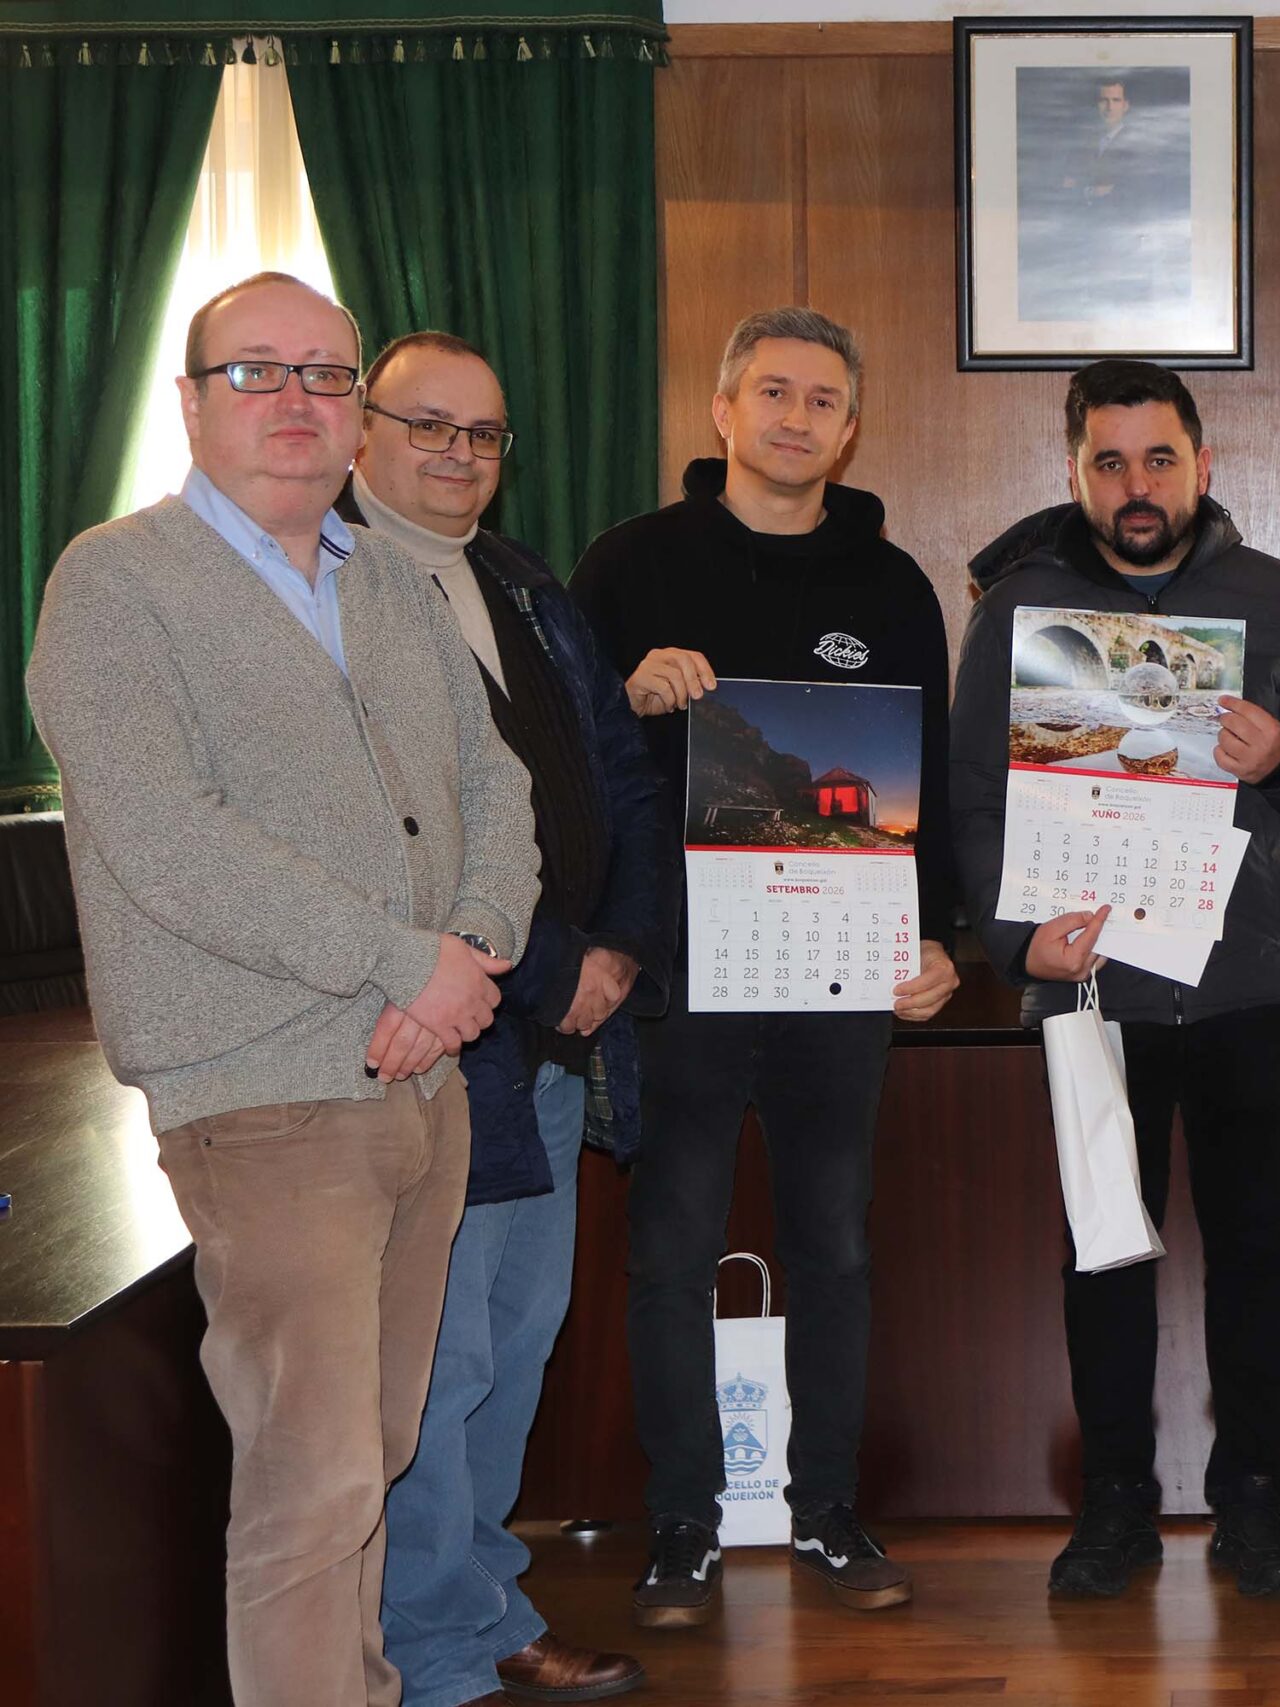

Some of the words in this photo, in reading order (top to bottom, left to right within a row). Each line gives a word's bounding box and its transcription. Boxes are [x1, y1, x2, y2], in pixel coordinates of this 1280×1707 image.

[813, 640, 870, 661] Dickies
[1091, 808, 1121, 820] XUÑO
[1122, 811, 1146, 822] 2026
[1035, 832, 1041, 842] 1
[1063, 834, 1070, 844] 2
[1093, 836, 1099, 846] 3
[1122, 839, 1128, 848] 4
[1152, 840, 1158, 851] 5
[1181, 842, 1188, 853] 6
[1212, 845, 1219, 855] 7
[1033, 850, 1040, 860] 8
[1063, 852, 1069, 863] 9
[1085, 854, 1098, 865] 10
[1116, 856, 1127, 867] 11
[1144, 858, 1157, 869] 12
[1174, 860, 1187, 871] 13
[1203, 863, 1216, 873] 14
[1027, 868, 1039, 878] 15
[1056, 870, 1068, 881] 16
[1085, 872, 1098, 883] 17
[1113, 875, 1127, 885] 18
[1144, 876, 1156, 887] 19
[1170, 878, 1185, 889] 20
[1200, 881, 1214, 892] 21
[766, 885, 820, 895] SETEMBRO
[822, 886, 845, 896] 2026
[1023, 886, 1037, 897] 22
[1053, 888, 1067, 899] 23
[1081, 890, 1096, 901] 24
[1110, 892, 1126, 904] 25
[1140, 895, 1154, 906] 26
[1170, 897, 1184, 907] 27
[1198, 899, 1213, 910] 28
[1020, 903, 1035, 914] 29
[1050, 905, 1066, 917] 30
[754, 911, 759, 922] 1
[782, 912, 789, 922] 2
[813, 912, 819, 923] 3
[842, 913, 849, 923] 4
[872, 914, 879, 924] 5
[901, 914, 908, 924] 6
[721, 929, 729, 940] 7
[752, 930, 759, 941] 8
[782, 930, 789, 941] 9
[806, 931, 819, 942] 10
[838, 932, 849, 942] 11
[867, 932, 879, 943] 12
[896, 933, 908, 943] 13
[715, 949, 728, 959] 14
[746, 949, 759, 960] 15
[777, 949, 789, 960] 16
[808, 950, 820, 960] 17
[837, 950, 849, 961] 18
[867, 950, 879, 961] 19
[894, 951, 909, 961] 20
[714, 967, 728, 978] 21
[744, 968, 758, 979] 22
[775, 968, 789, 979] 23
[805, 968, 819, 979] 24
[835, 969, 849, 980] 25
[865, 969, 879, 980] 26
[894, 969, 910, 980] 27
[712, 986, 728, 997] 28
[744, 987, 758, 997] 29
[774, 987, 789, 998] 30
[727, 1480, 761, 1489] CELLO
[765, 1479, 779, 1488] DE
